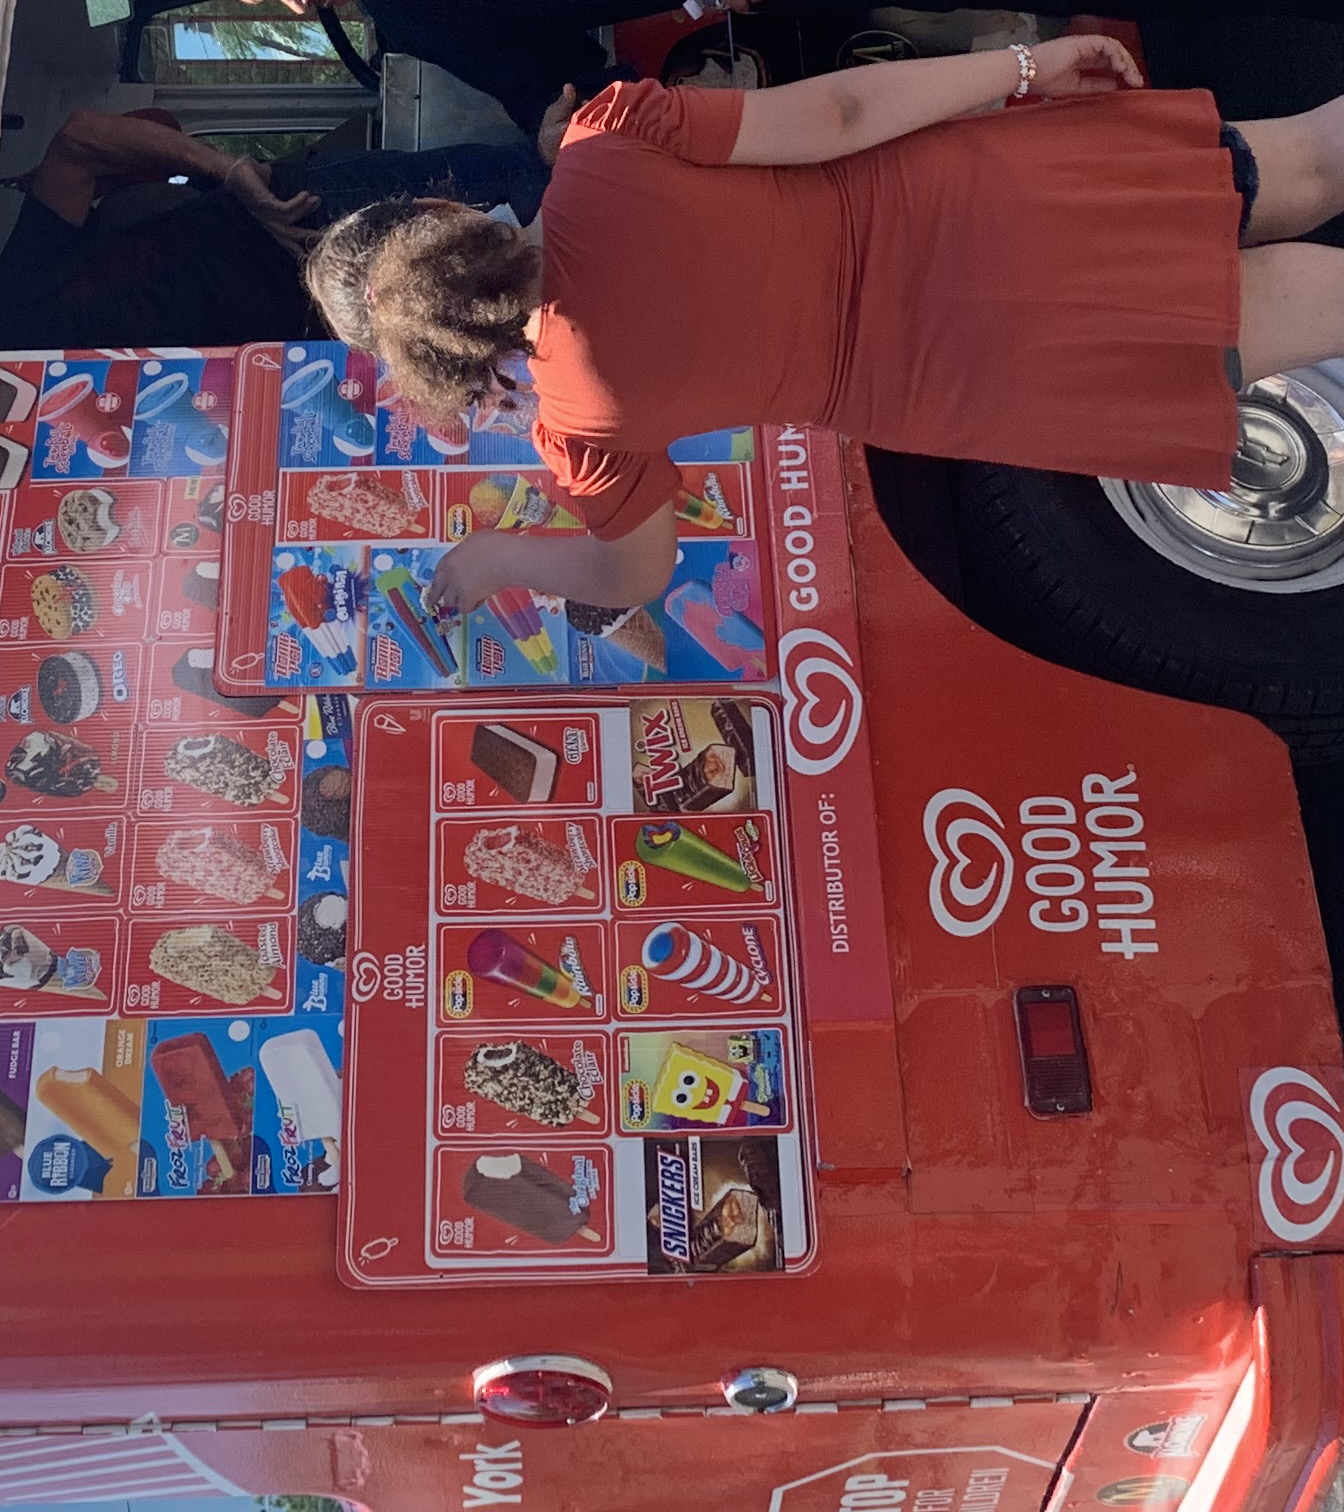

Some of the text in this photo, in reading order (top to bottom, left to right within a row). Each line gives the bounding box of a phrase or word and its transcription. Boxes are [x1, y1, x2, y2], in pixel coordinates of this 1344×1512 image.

[187, 478, 197, 497] NEW
[704, 472, 735, 520] Rainbow
[248, 494, 261, 521] GOOD
[262, 490, 276, 526] HUMOR
[783, 505, 819, 611] GOOD
[112, 651, 127, 701] OREO
[492, 640, 504, 673] POP
[268, 732, 286, 782] Chocolate
[278, 741, 295, 769] Eclair
[565, 727, 580, 762] GIANT
[457, 783, 465, 802] GOOD
[465, 778, 475, 805] HUMOR
[103, 823, 117, 857] Vanilla
[261, 823, 279, 875] Strawberry
[271, 827, 289, 869] Shortcake
[567, 823, 588, 874] Strawberry
[577, 825, 596, 869] Shortcake
[626, 864, 639, 901] Popsicle
[818, 793, 850, 953] DISTRIBUTOR OF:
[1019, 796, 1089, 932] GOOD
[1081, 770, 1159, 960] HUMOR
[457, 885, 467, 905] GOOD
[466, 880, 477, 908] HUMOR
[258, 924, 270, 967] Toasted
[269, 922, 284, 967] Almond
[743, 926, 772, 985] CYCLONE
[383, 954, 404, 1000] GOOD
[404, 944, 426, 1009] HUMOR
[563, 935, 592, 996] Rainbow
[141, 985, 151, 1006] GOOD
[150, 981, 160, 1009] HUMOR
[452, 975, 464, 1012] Popsicle
[629, 969, 641, 1007] Popsicle
[9, 1030, 21, 1079] FUDGE BAR
[115, 1029, 126, 1068] ORANGE
[124, 1032, 134, 1065] DREAM
[582, 1051, 602, 1084] Eclair
[572, 1041, 594, 1098] Chocolate
[457, 1106, 466, 1128] GOOD
[466, 1101, 476, 1131] HUMOR
[630, 1083, 643, 1122] Popsicle
[42, 1152, 52, 1179] BLUE
[50, 1142, 71, 1187] RIBBON
[570, 1155, 588, 1207] Original
[690, 1141, 700, 1206] ICE CREAM BARS
[660, 1155, 687, 1257] SNICKERS
[455, 1222, 464, 1245] GOOD
[464, 1217, 475, 1248] HUMOR
[458, 1439, 524, 1508] York
[912, 1488, 956, 1512] FOR
